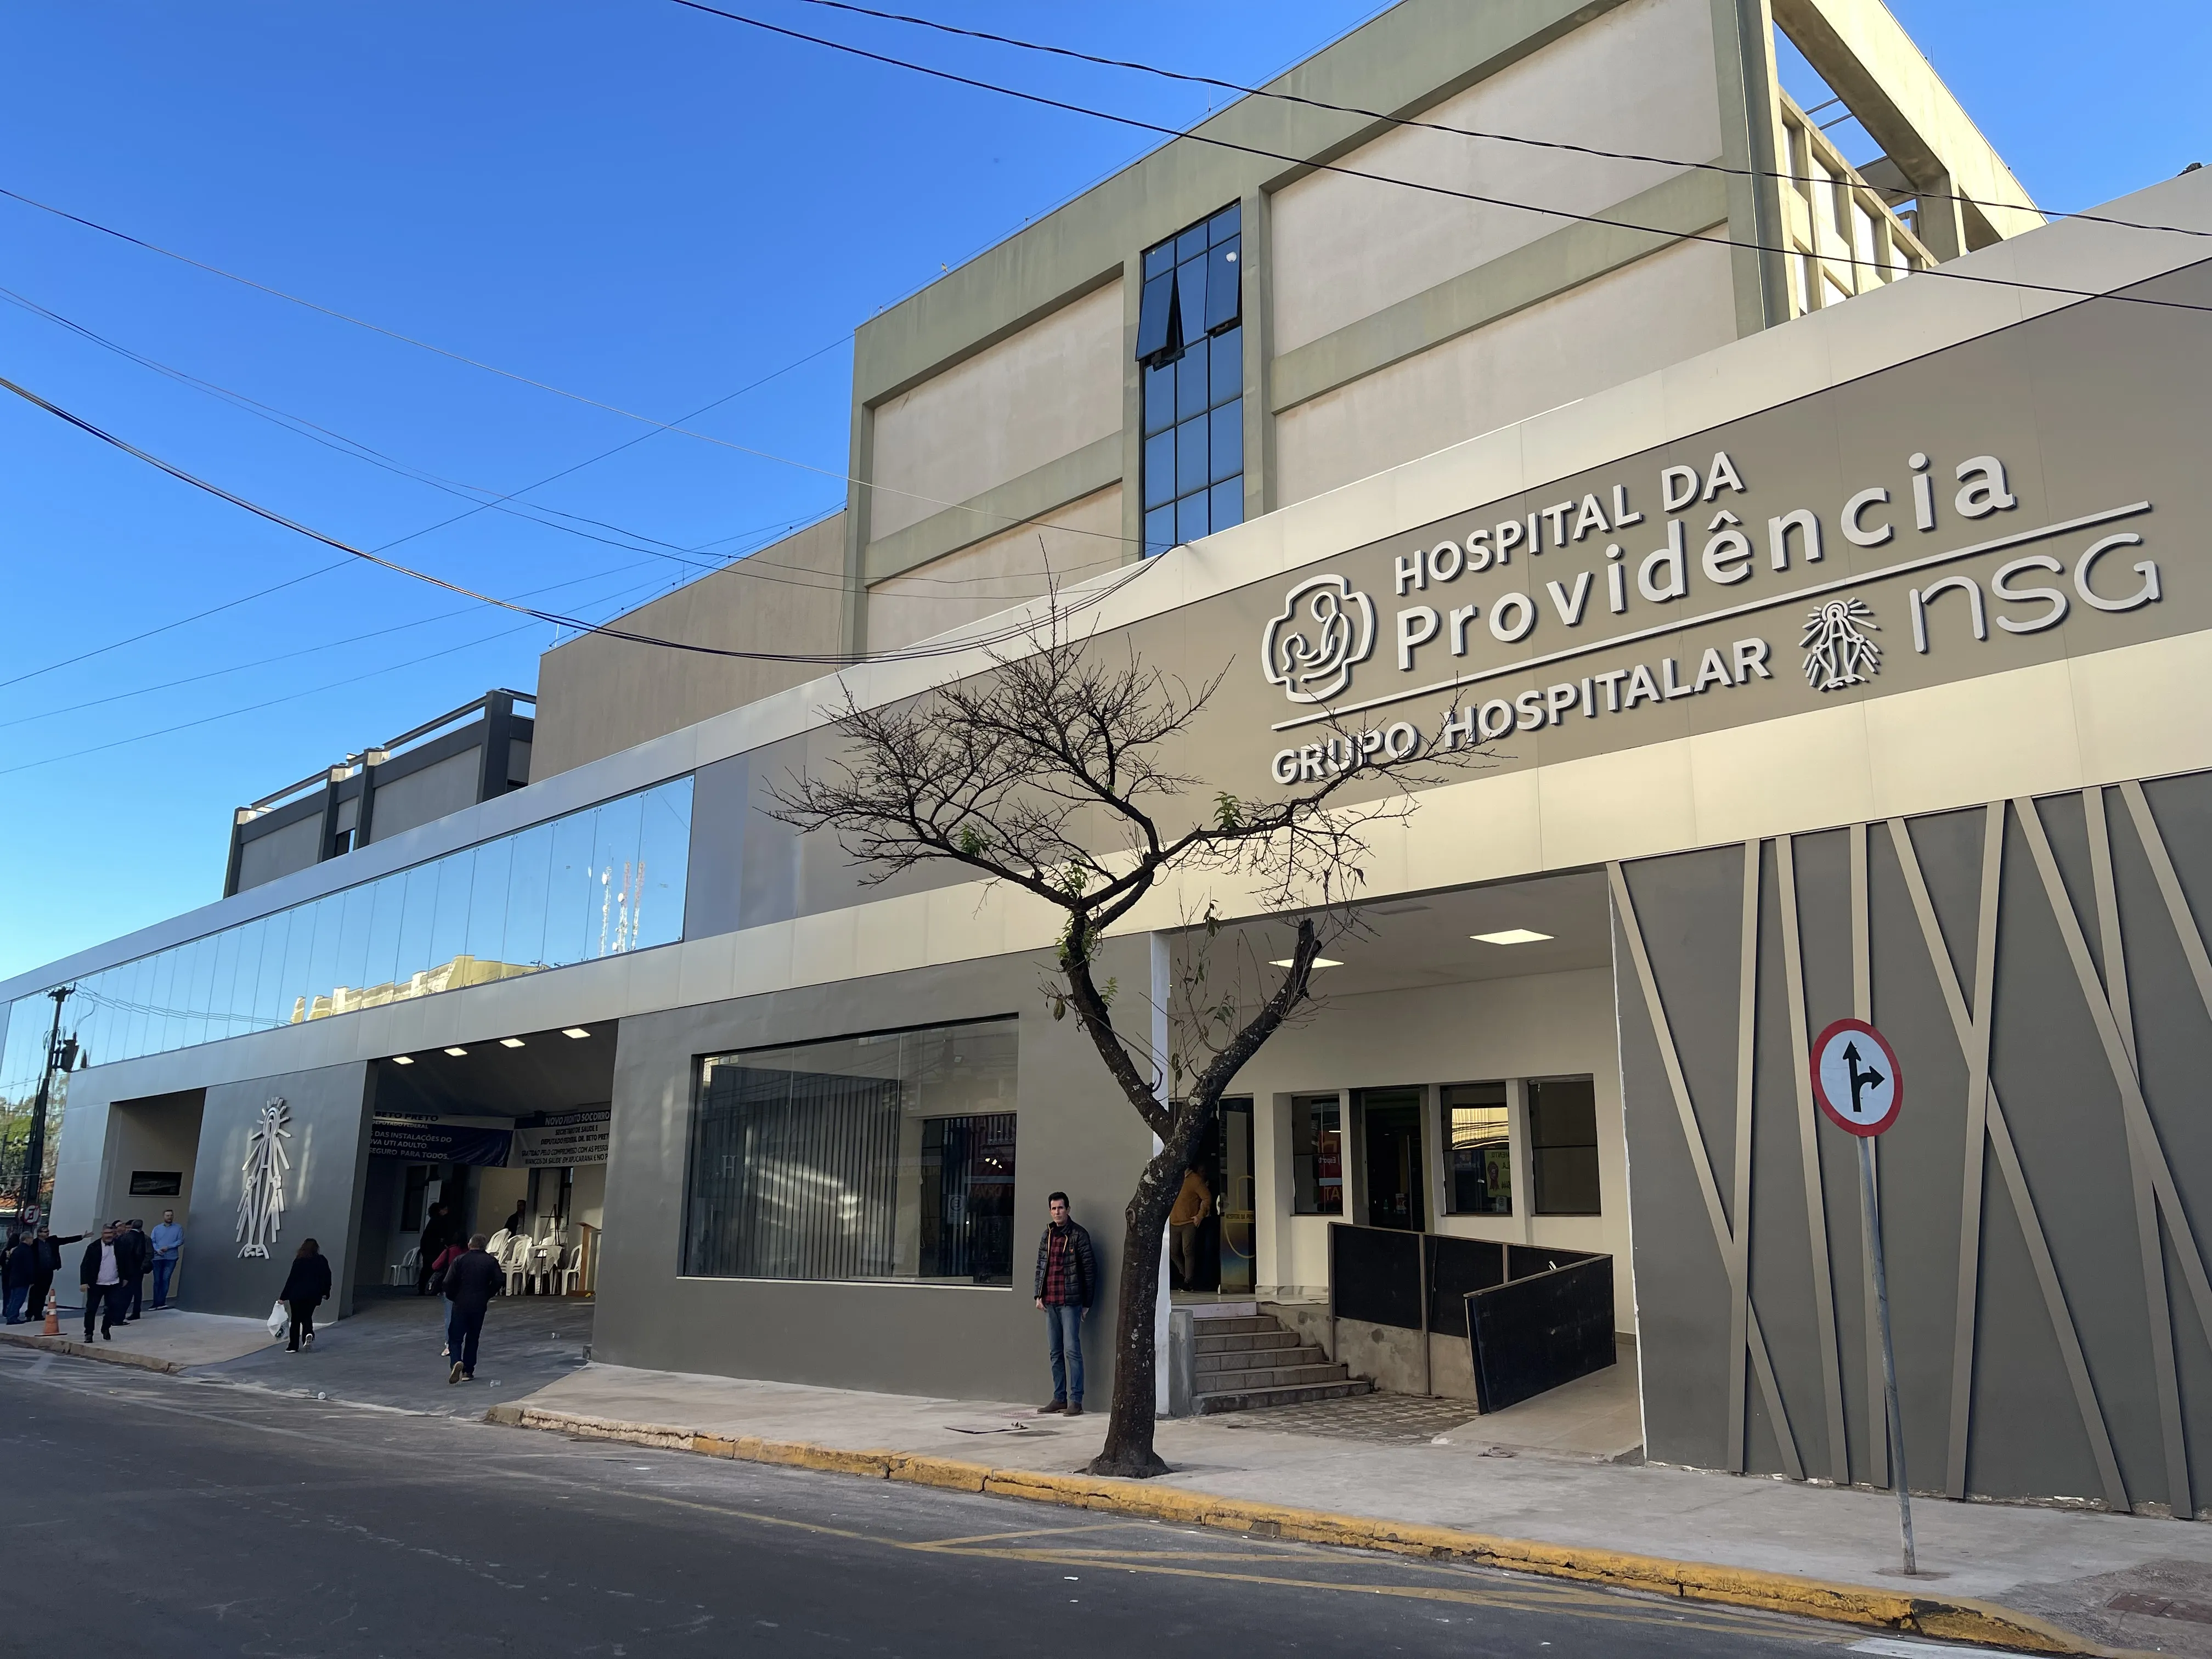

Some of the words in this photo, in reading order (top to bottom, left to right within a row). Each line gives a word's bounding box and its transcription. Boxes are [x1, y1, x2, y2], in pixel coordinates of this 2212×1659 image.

[1395, 483, 1643, 596] HOSPITAL
[1662, 450, 1746, 513] DA
[1396, 452, 2017, 671] Providência
[1271, 721, 1420, 785] GRUPO
[1444, 636, 1772, 749] HOSPITALAR
[391, 1132, 439, 1142] INSTALAÇÕES
[405, 1113, 439, 1122] PRETO
[545, 1116, 563, 1126] NOVO
